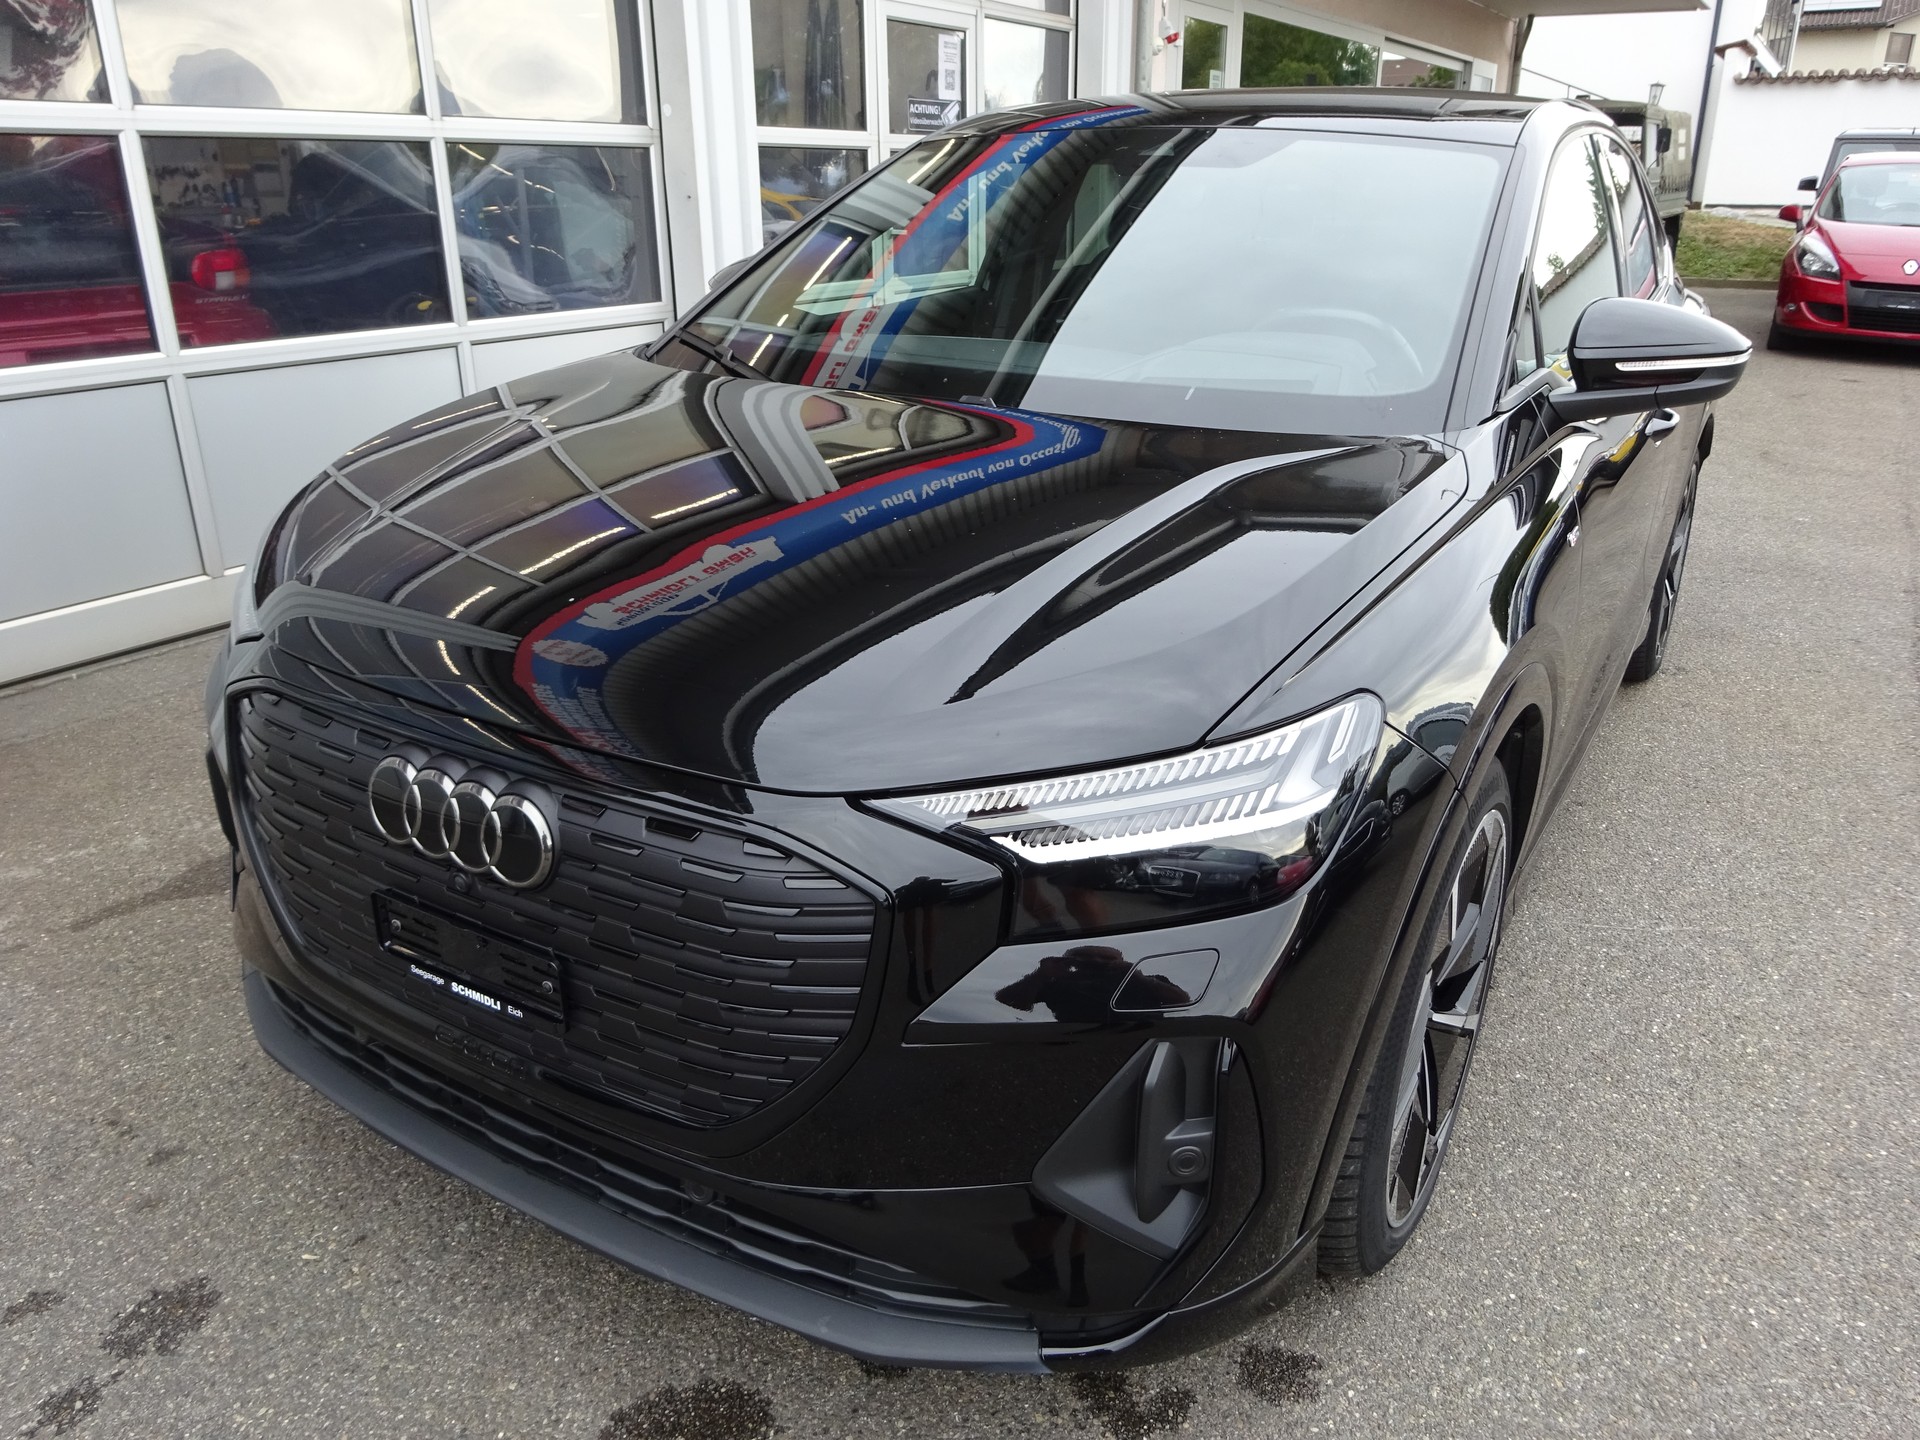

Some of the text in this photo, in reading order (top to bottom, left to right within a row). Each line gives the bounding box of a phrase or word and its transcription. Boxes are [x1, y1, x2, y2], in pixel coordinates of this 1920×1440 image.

[909, 103, 941, 115] ACHTUNG!
[410, 964, 523, 1018] Seegarage SCHMIDLI Eich
